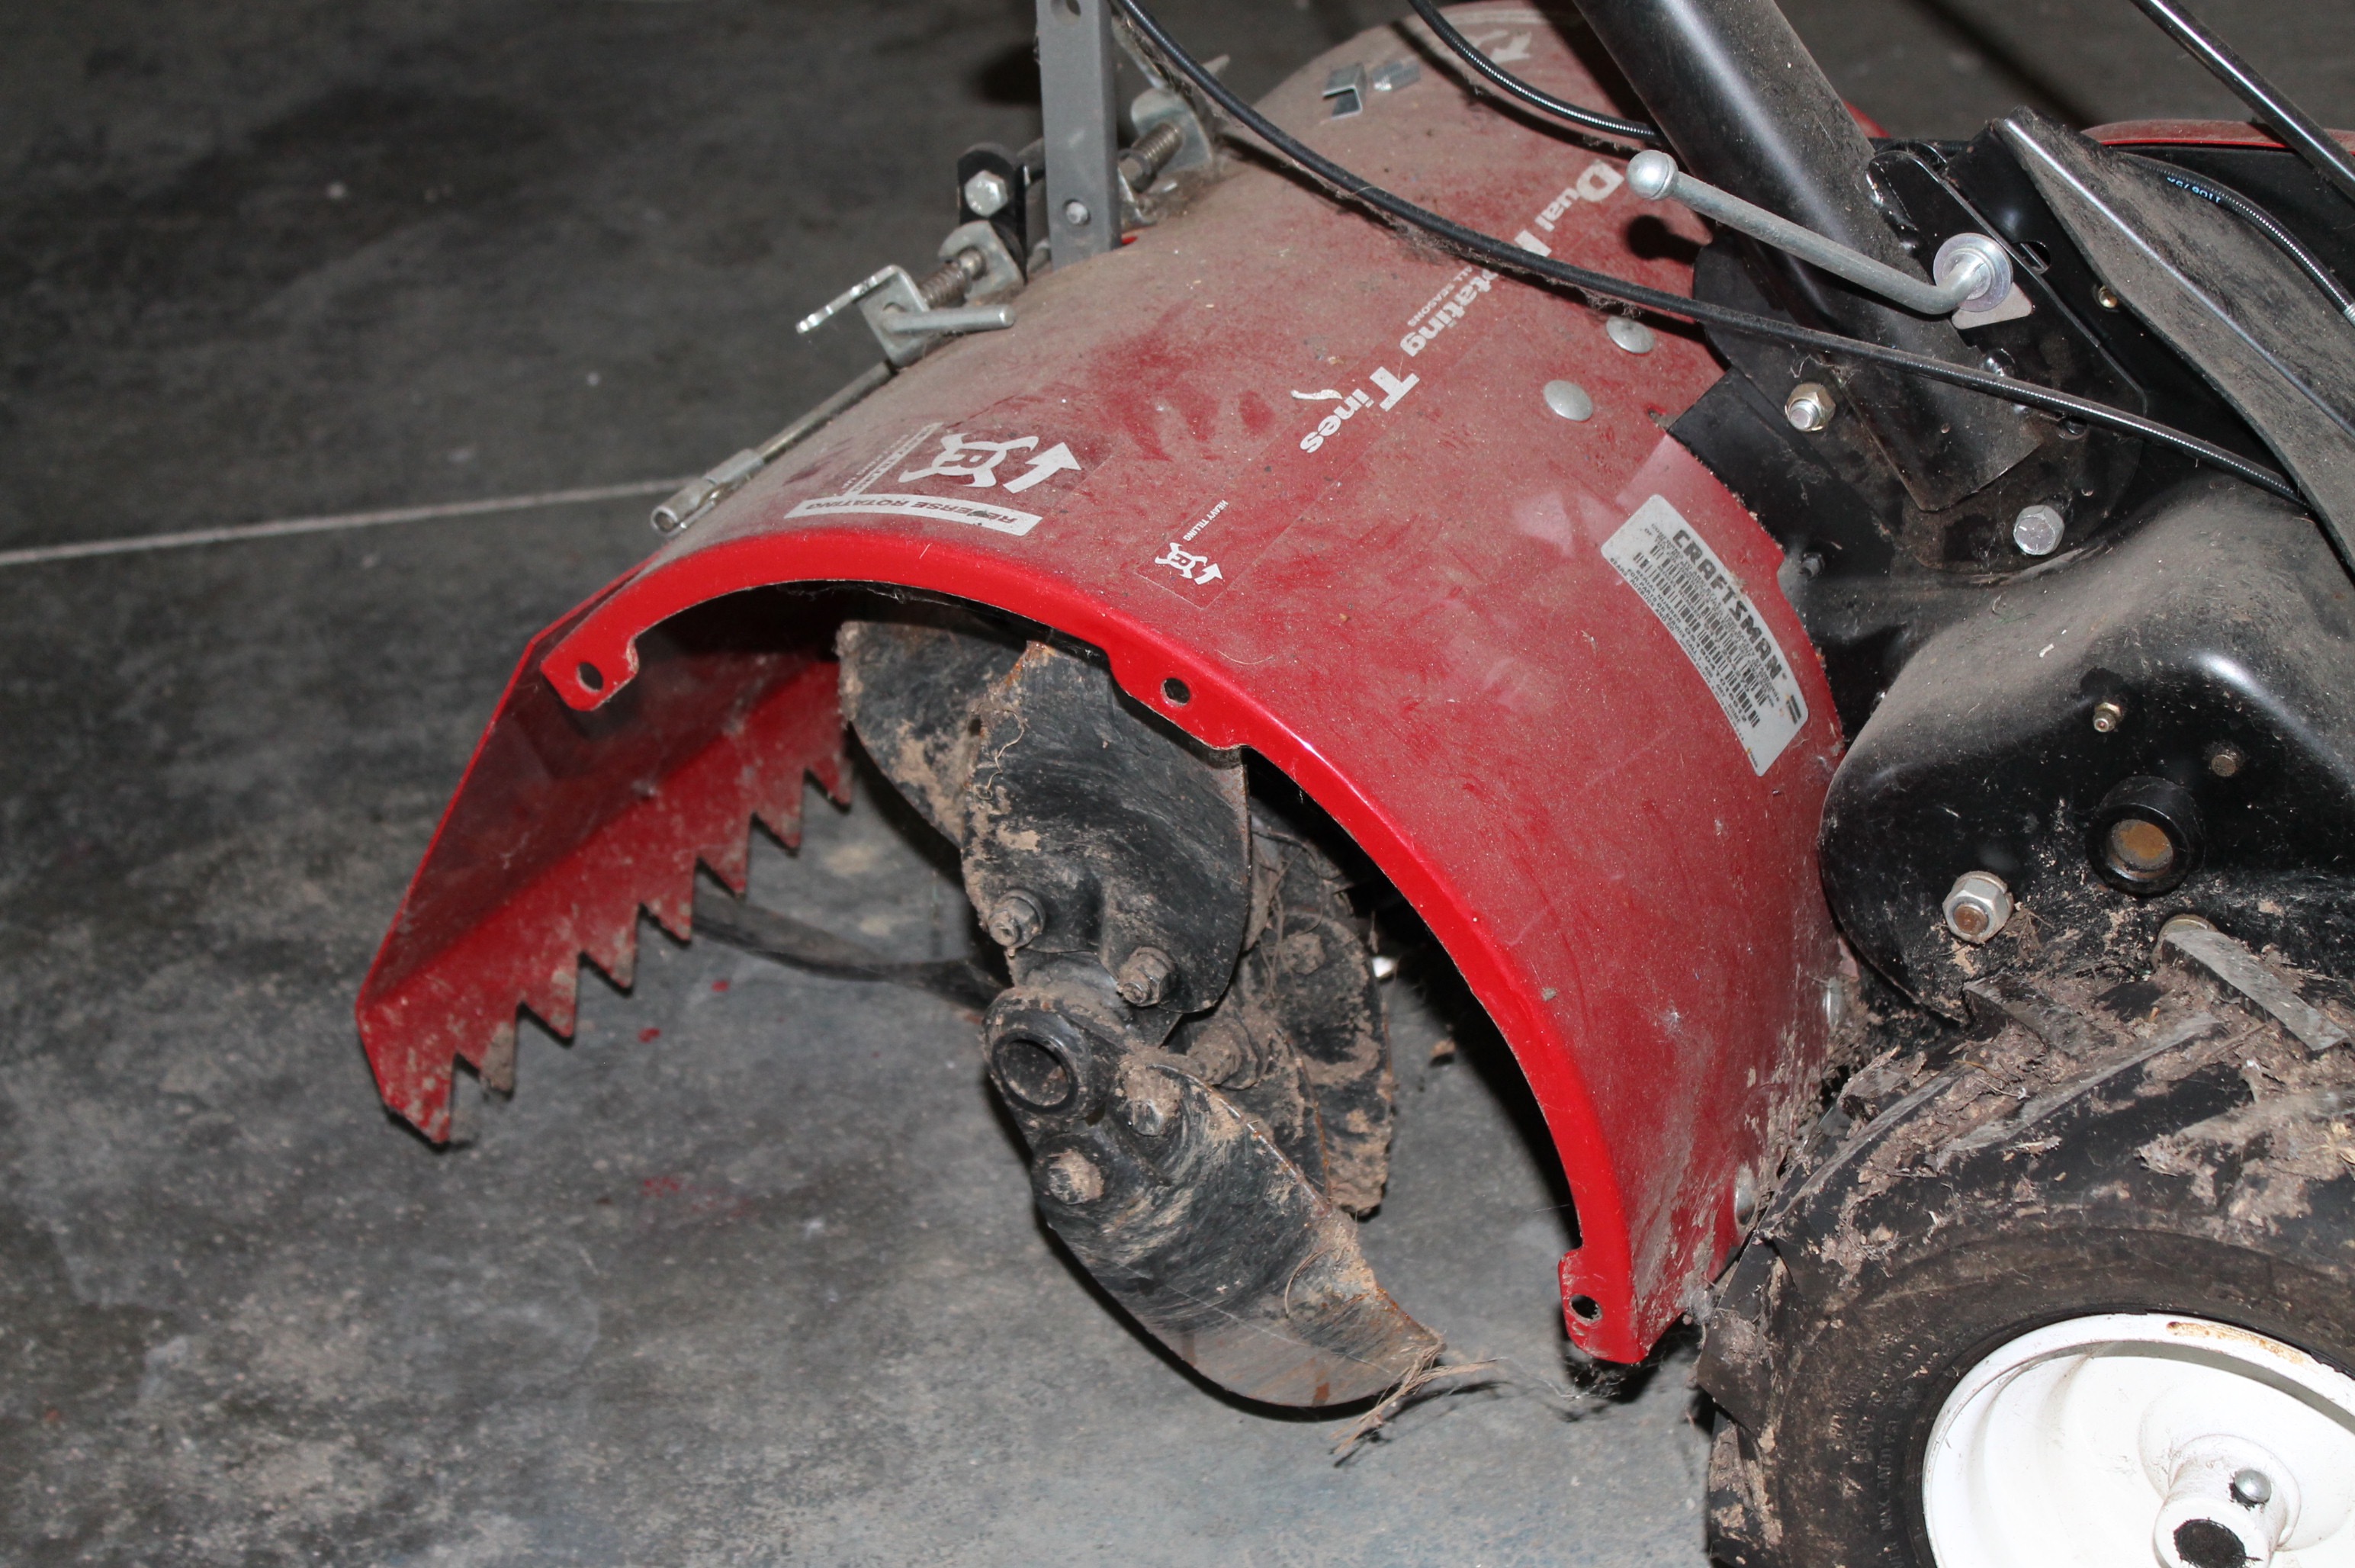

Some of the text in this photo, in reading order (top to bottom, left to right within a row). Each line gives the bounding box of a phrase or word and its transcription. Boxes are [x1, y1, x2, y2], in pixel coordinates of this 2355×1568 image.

[1535, 159, 1624, 231] Dual
[1407, 265, 1472, 326] ALL SEASONS
[1300, 366, 1419, 453] Tines
[1183, 500, 1229, 541] HEAVY TILLING
[1627, 567, 1640, 582] FOR
[1638, 580, 1657, 603] PARTS
[1656, 601, 1666, 613] OR
[1664, 612, 1687, 639] SERVICE
[1684, 638, 1698, 655] CALL
[1629, 578, 1655, 608] ROEBUCK
[1654, 607, 1667, 622] AND
[1635, 568, 1656, 593] SERIAL
[1656, 593, 1682, 624] NUMBER
[1672, 529, 1783, 681] CRAFTSMAN
